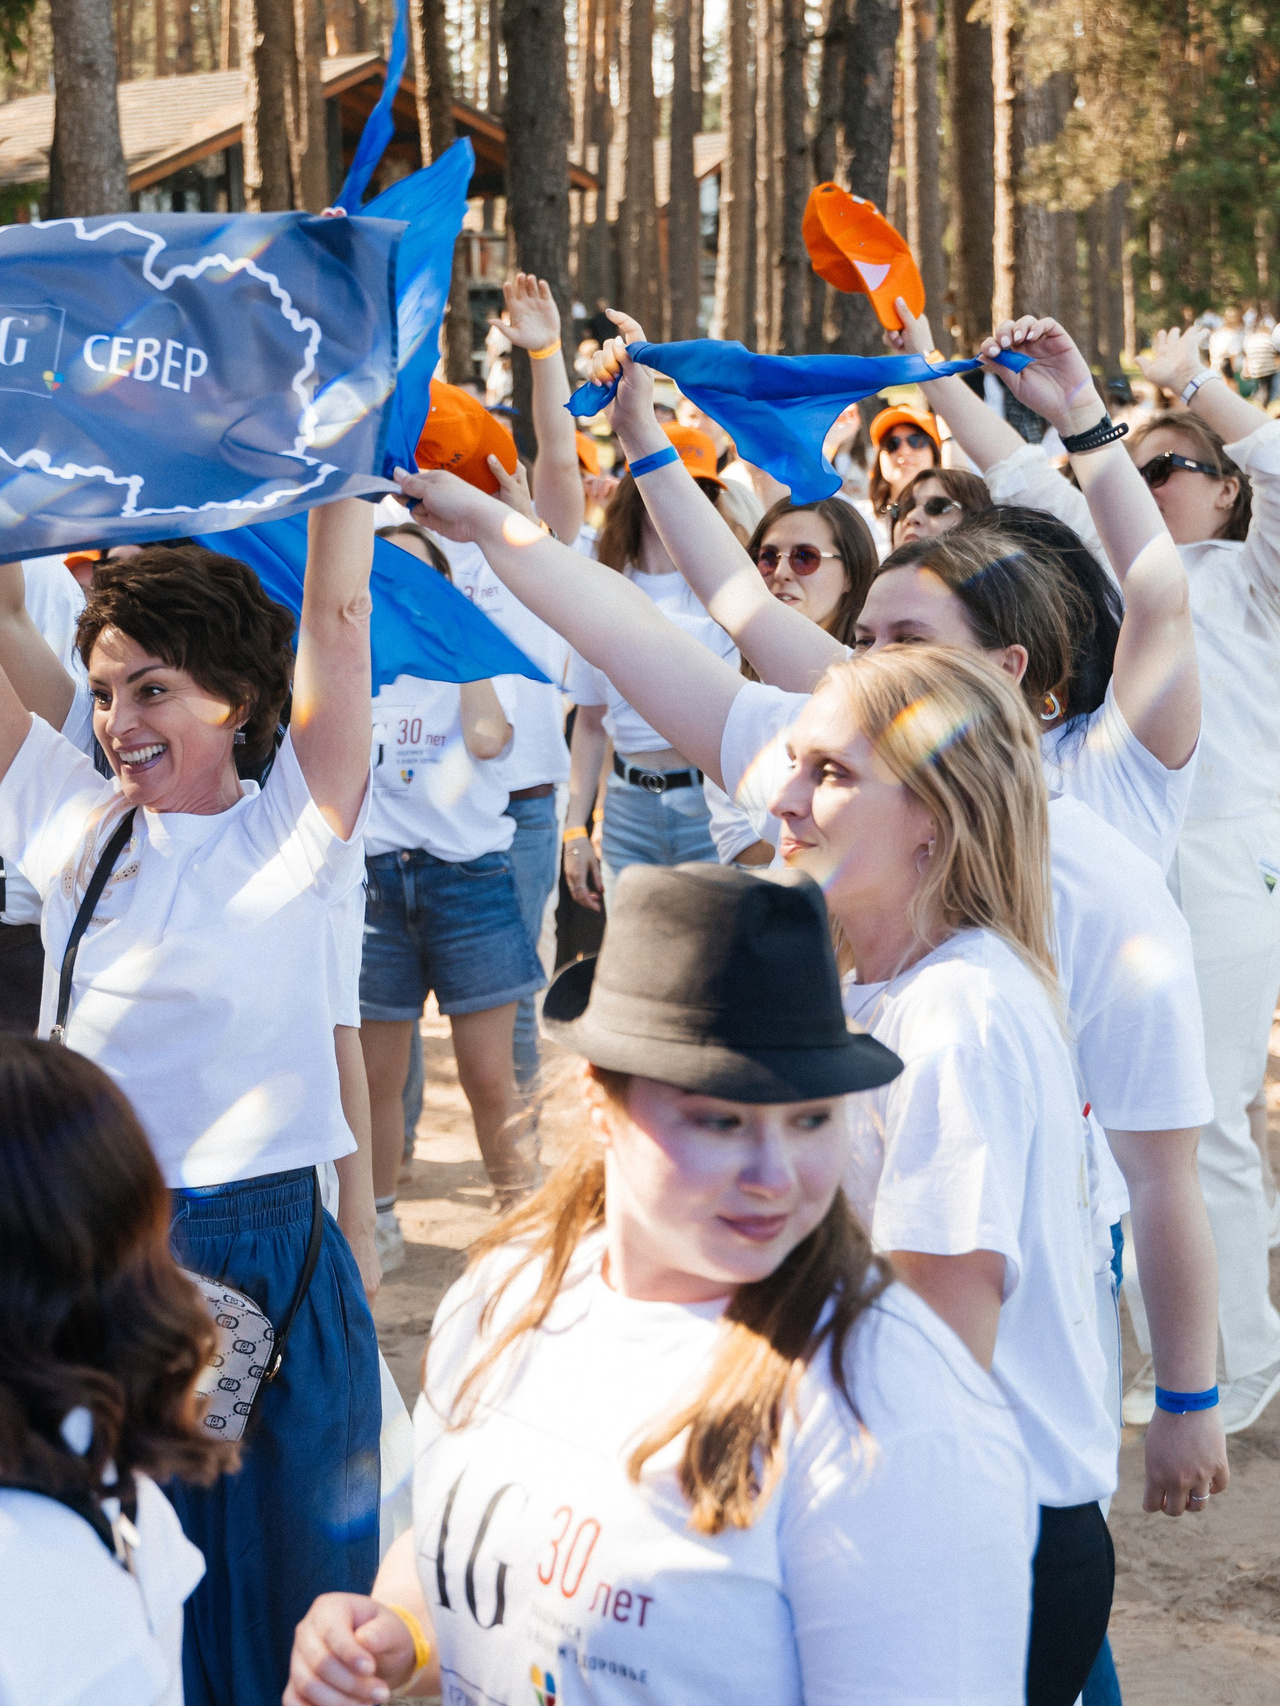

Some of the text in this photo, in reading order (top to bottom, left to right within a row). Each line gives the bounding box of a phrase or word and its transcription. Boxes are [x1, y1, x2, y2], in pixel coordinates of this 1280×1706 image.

[82, 333, 210, 394] СЕВЕР
[397, 718, 447, 747] 30 лет
[537, 1504, 602, 1599] 30
[588, 1582, 655, 1628] лет
